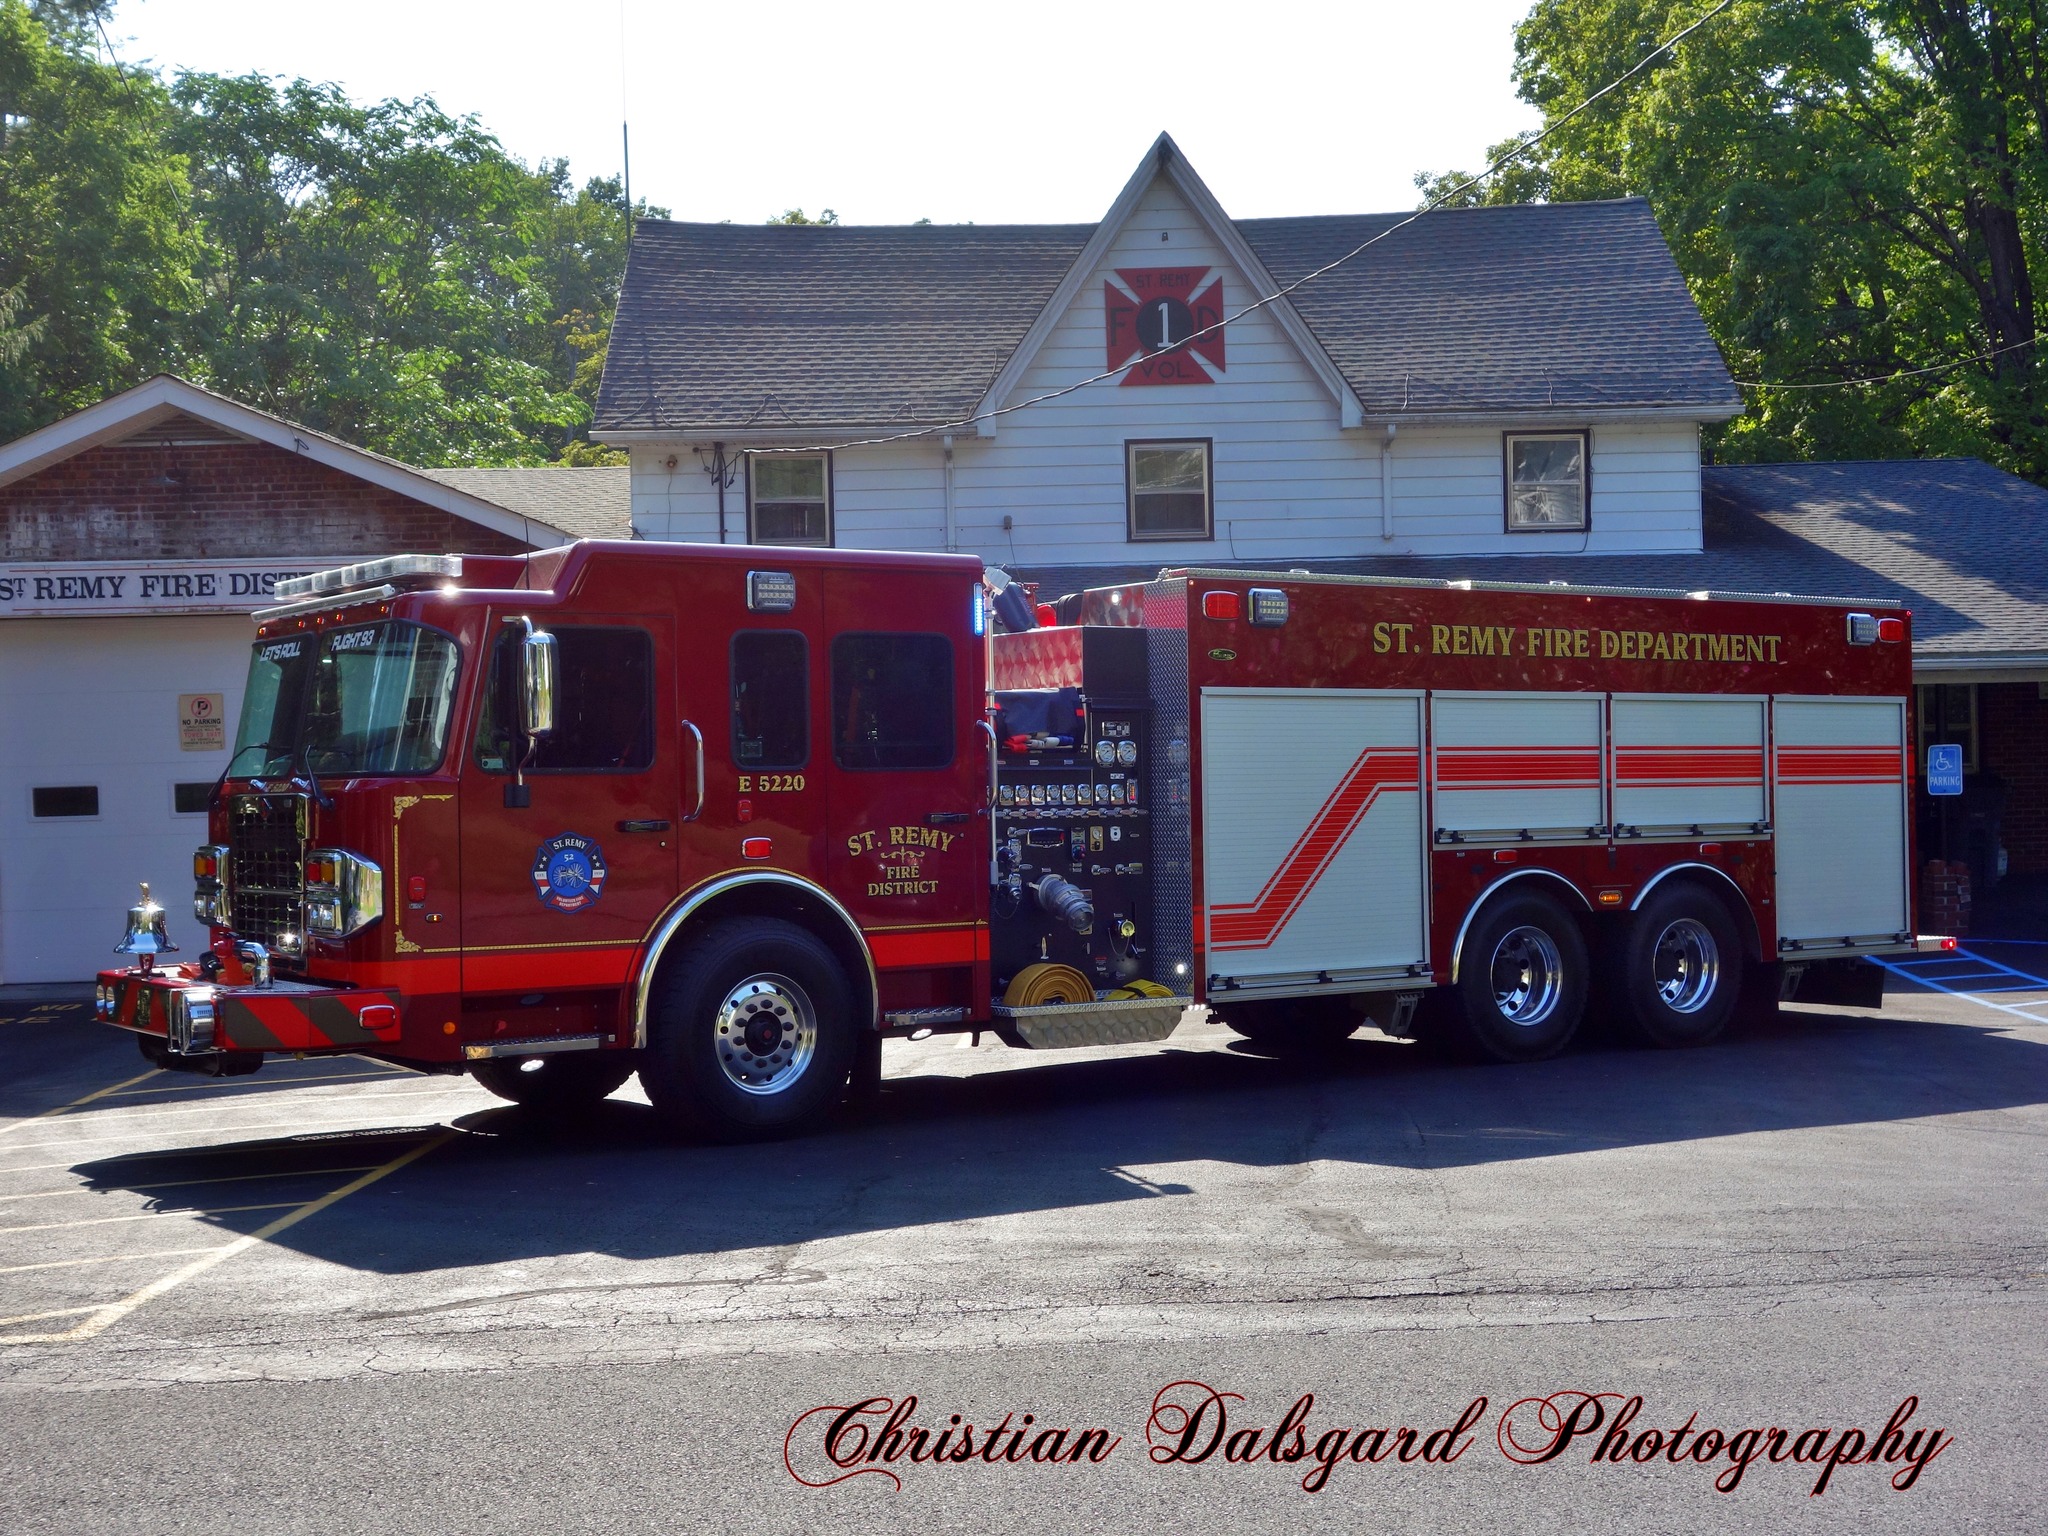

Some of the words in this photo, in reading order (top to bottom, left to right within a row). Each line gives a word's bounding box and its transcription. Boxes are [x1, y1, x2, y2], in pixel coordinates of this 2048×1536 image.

[1159, 272, 1191, 288] REMY
[1110, 306, 1133, 347] F
[1157, 302, 1175, 348] 1
[1197, 305, 1219, 344] D
[33, 576, 126, 600] REMY
[140, 574, 216, 598] FIRE
[331, 631, 362, 651] FLIGHT
[360, 629, 375, 647] 93
[1372, 621, 1421, 654] ST.
[1431, 624, 1517, 657] REMY
[1527, 627, 1591, 658] FIRE
[1600, 629, 1782, 663] DEPARTMENT
[280, 641, 301, 658] ROLL
[182, 718, 192, 726] NO
[738, 775, 752, 792] E
[758, 774, 806, 792] 5220
[1929, 775, 1960, 787] PARKING
[564, 838, 588, 850] REMY
[847, 829, 882, 857] ST.
[889, 826, 956, 852] REMY
[563, 853, 575, 863] 52
[886, 865, 920, 879] FIRE
[867, 880, 939, 897] DISTRICT
